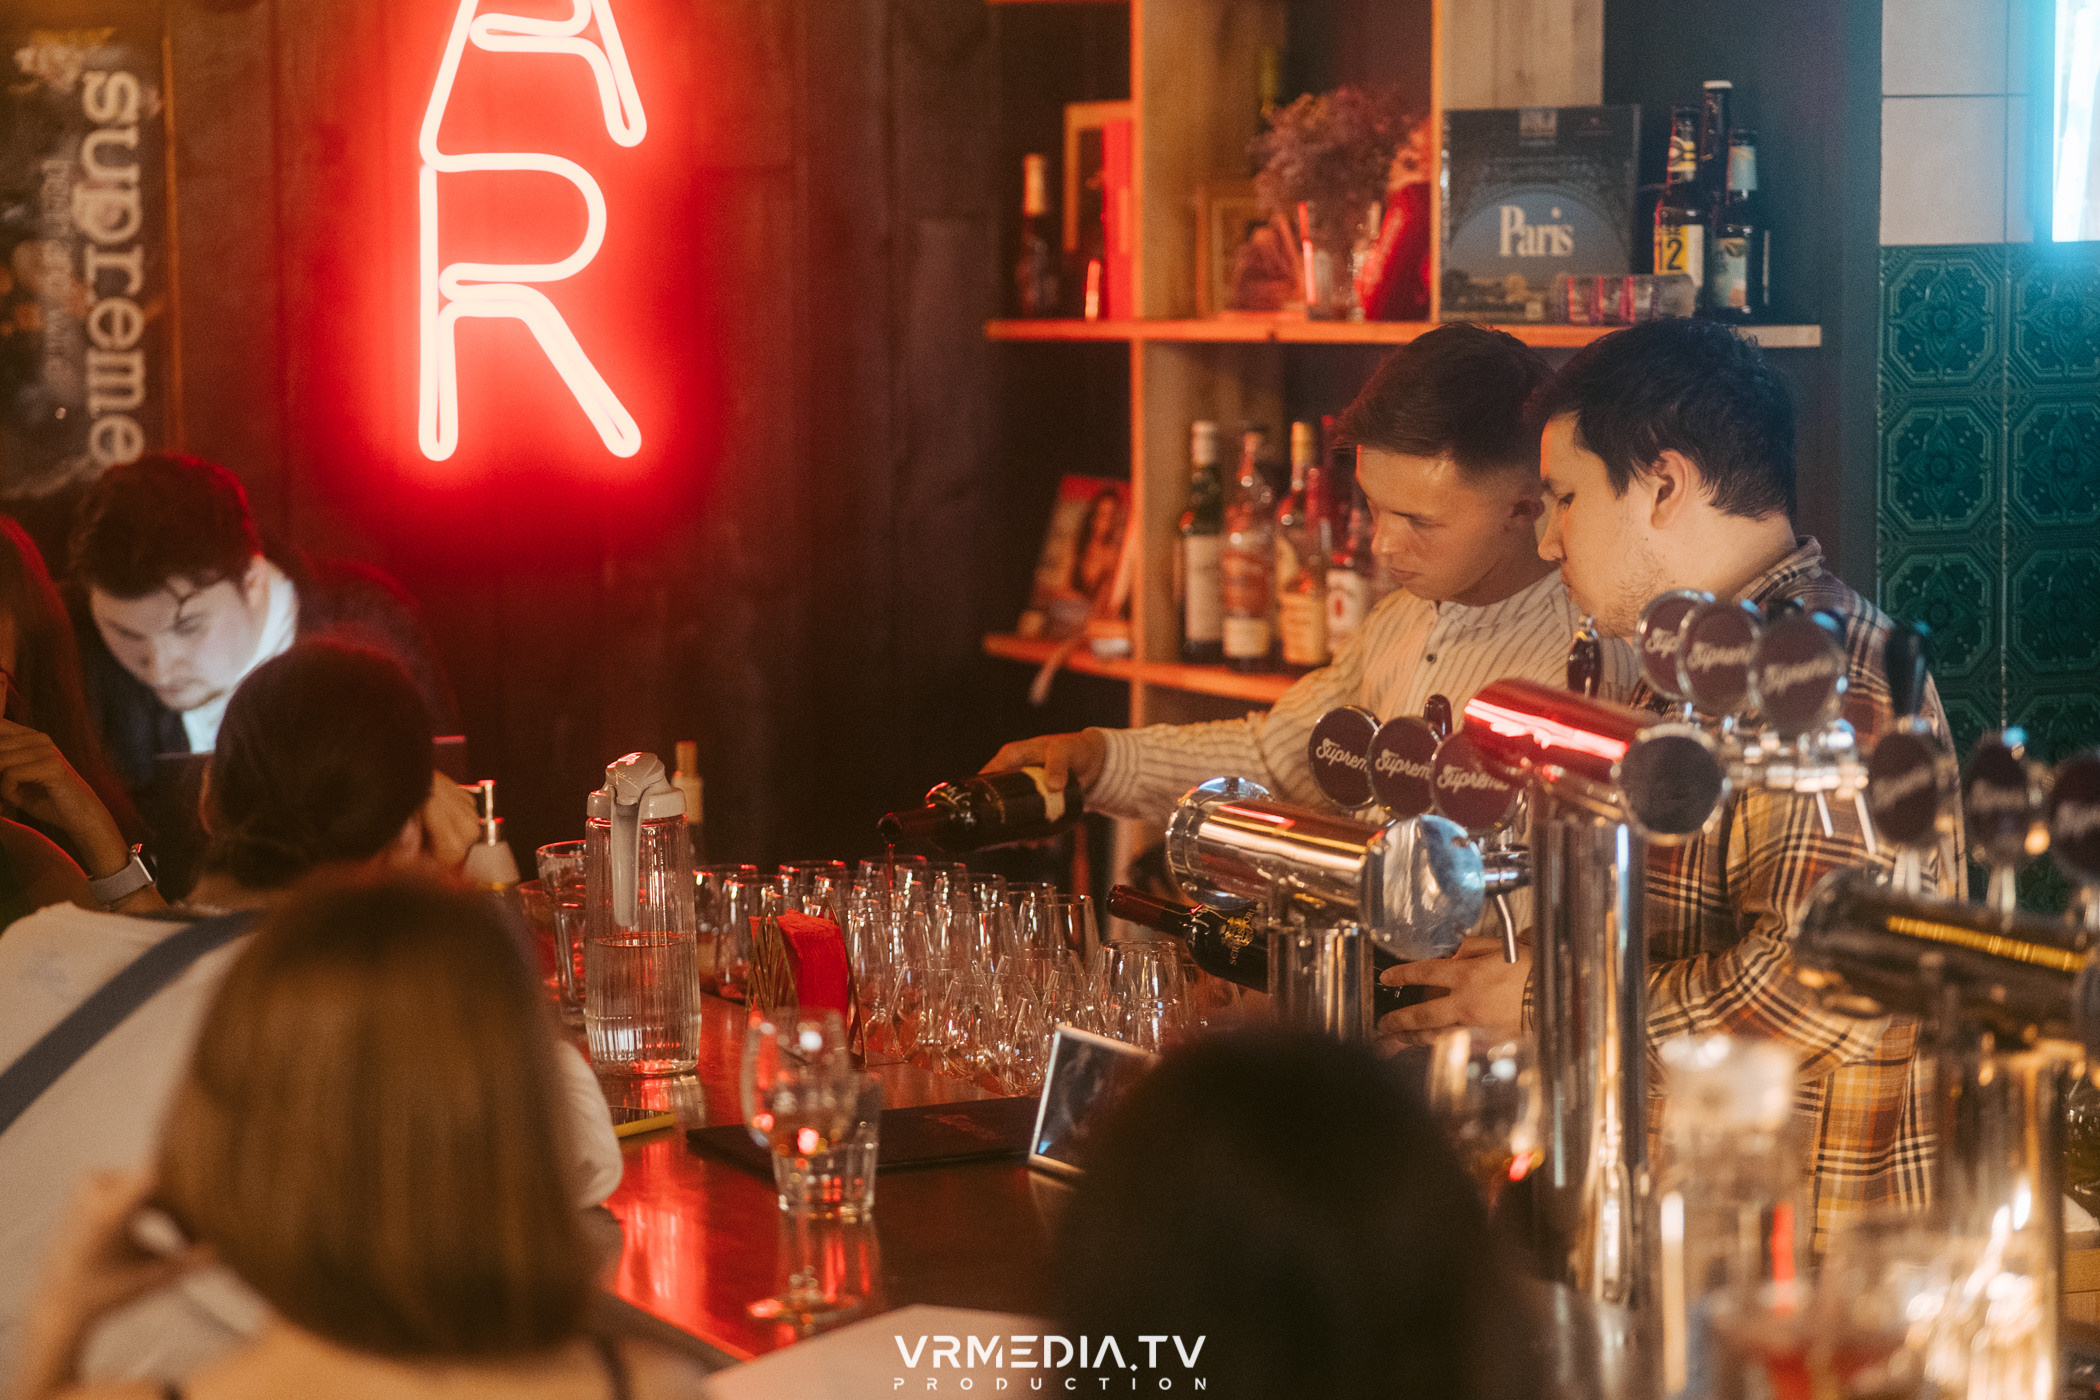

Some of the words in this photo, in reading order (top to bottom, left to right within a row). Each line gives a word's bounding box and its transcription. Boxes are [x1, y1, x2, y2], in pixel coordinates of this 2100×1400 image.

[1500, 204, 1575, 257] Paris
[73, 70, 146, 467] supreme
[1375, 749, 1431, 780] Suprem
